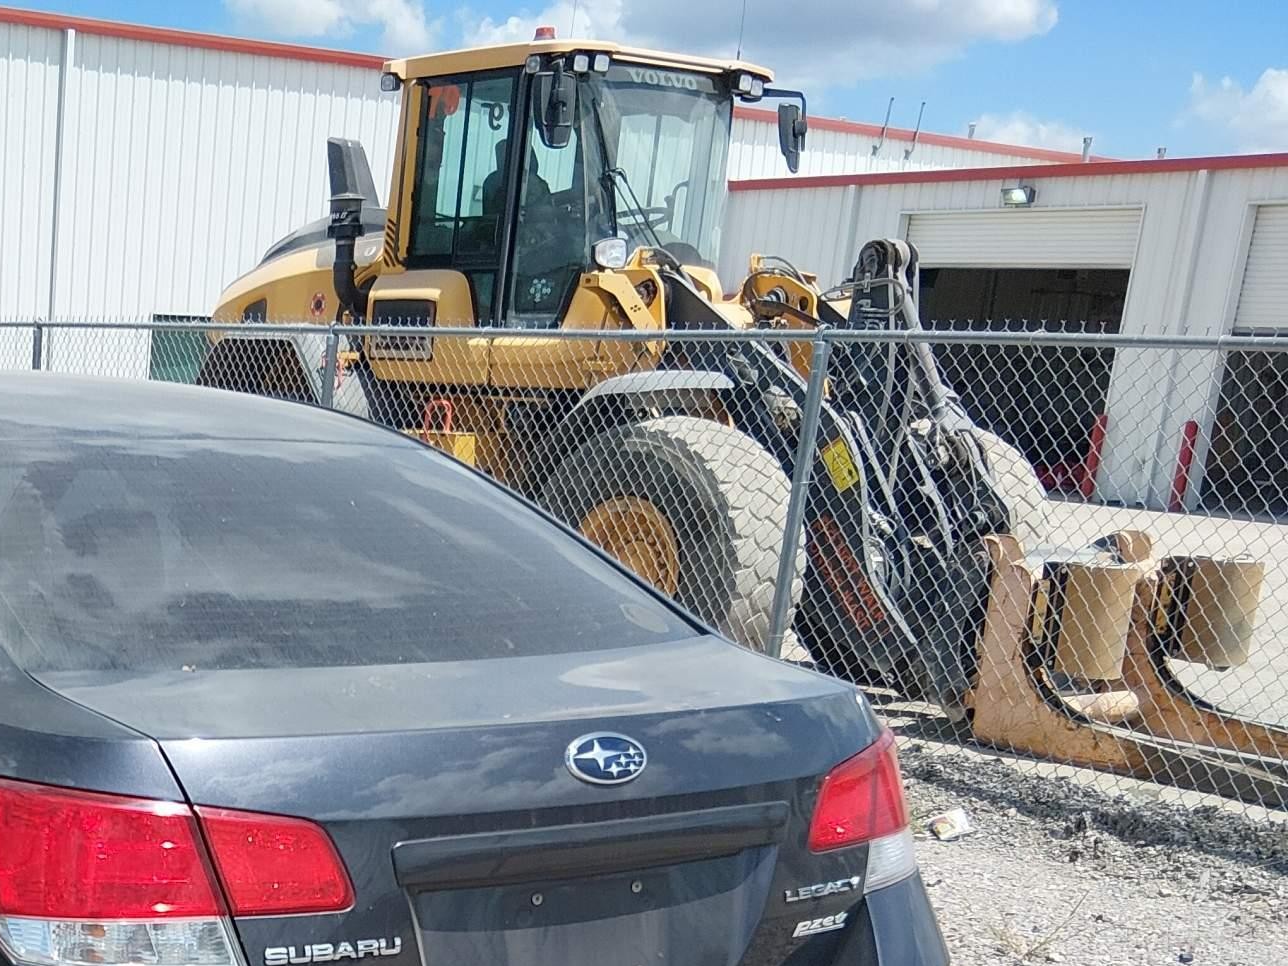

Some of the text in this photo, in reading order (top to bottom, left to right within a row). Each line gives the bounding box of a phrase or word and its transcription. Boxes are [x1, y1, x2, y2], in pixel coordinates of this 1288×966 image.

[626, 67, 697, 90] VOLVO
[785, 876, 861, 903] LEGACY
[264, 936, 402, 966] SUBARU
